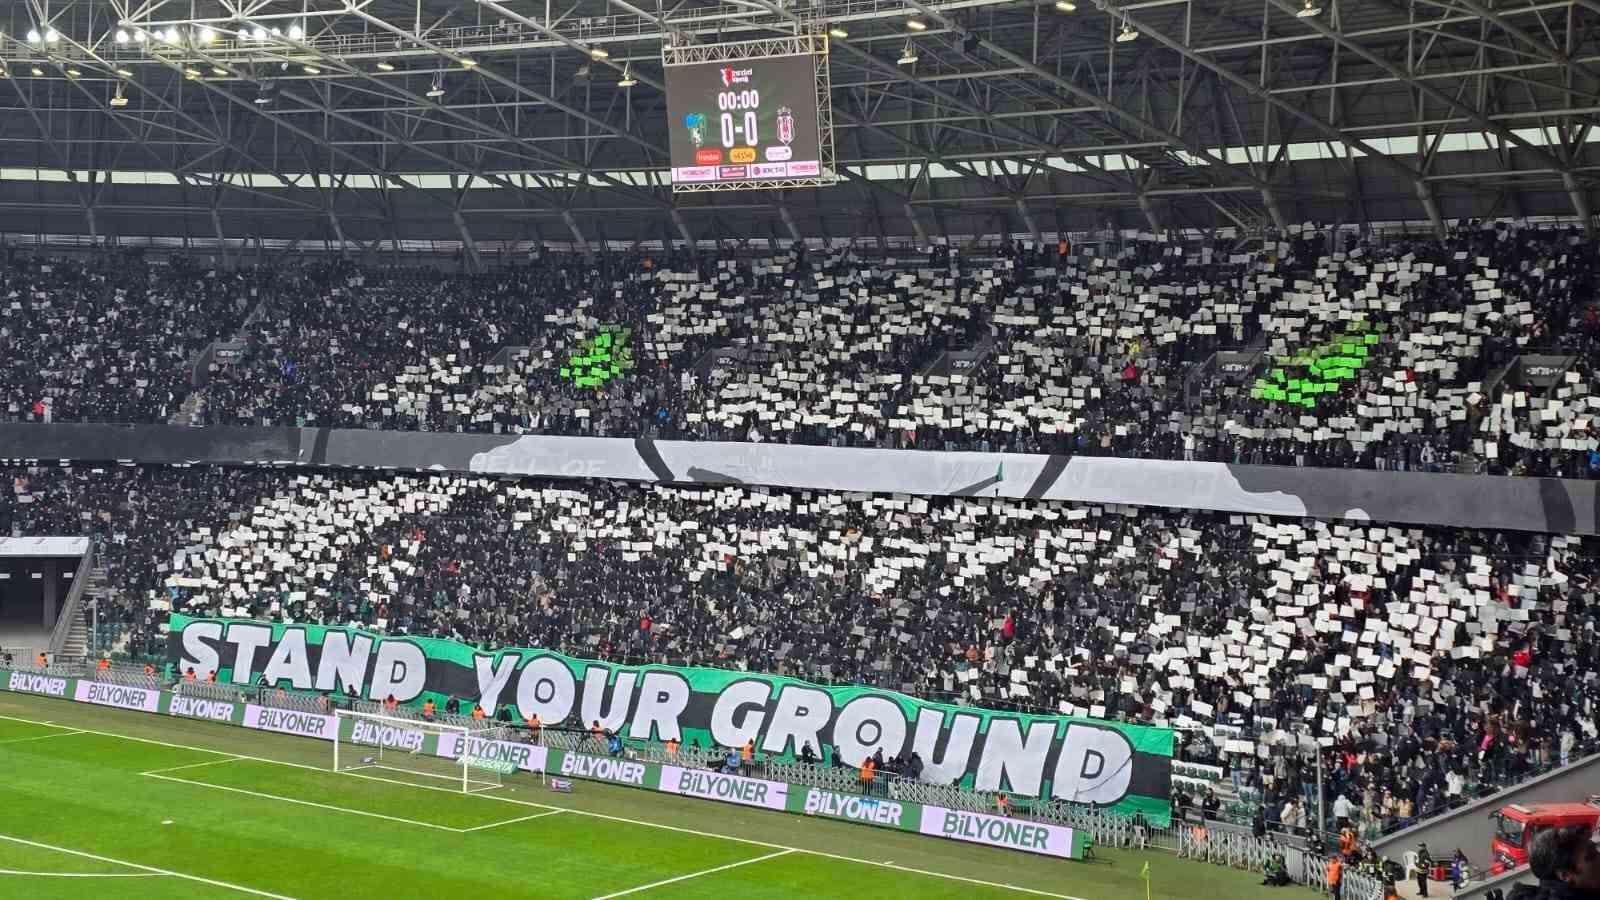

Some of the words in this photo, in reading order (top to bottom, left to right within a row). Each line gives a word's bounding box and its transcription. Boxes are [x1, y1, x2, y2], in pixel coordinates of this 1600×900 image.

[718, 89, 759, 110] 00:00
[180, 620, 426, 701] STAND
[473, 653, 691, 743] YOUR
[710, 680, 1135, 806] GROUND
